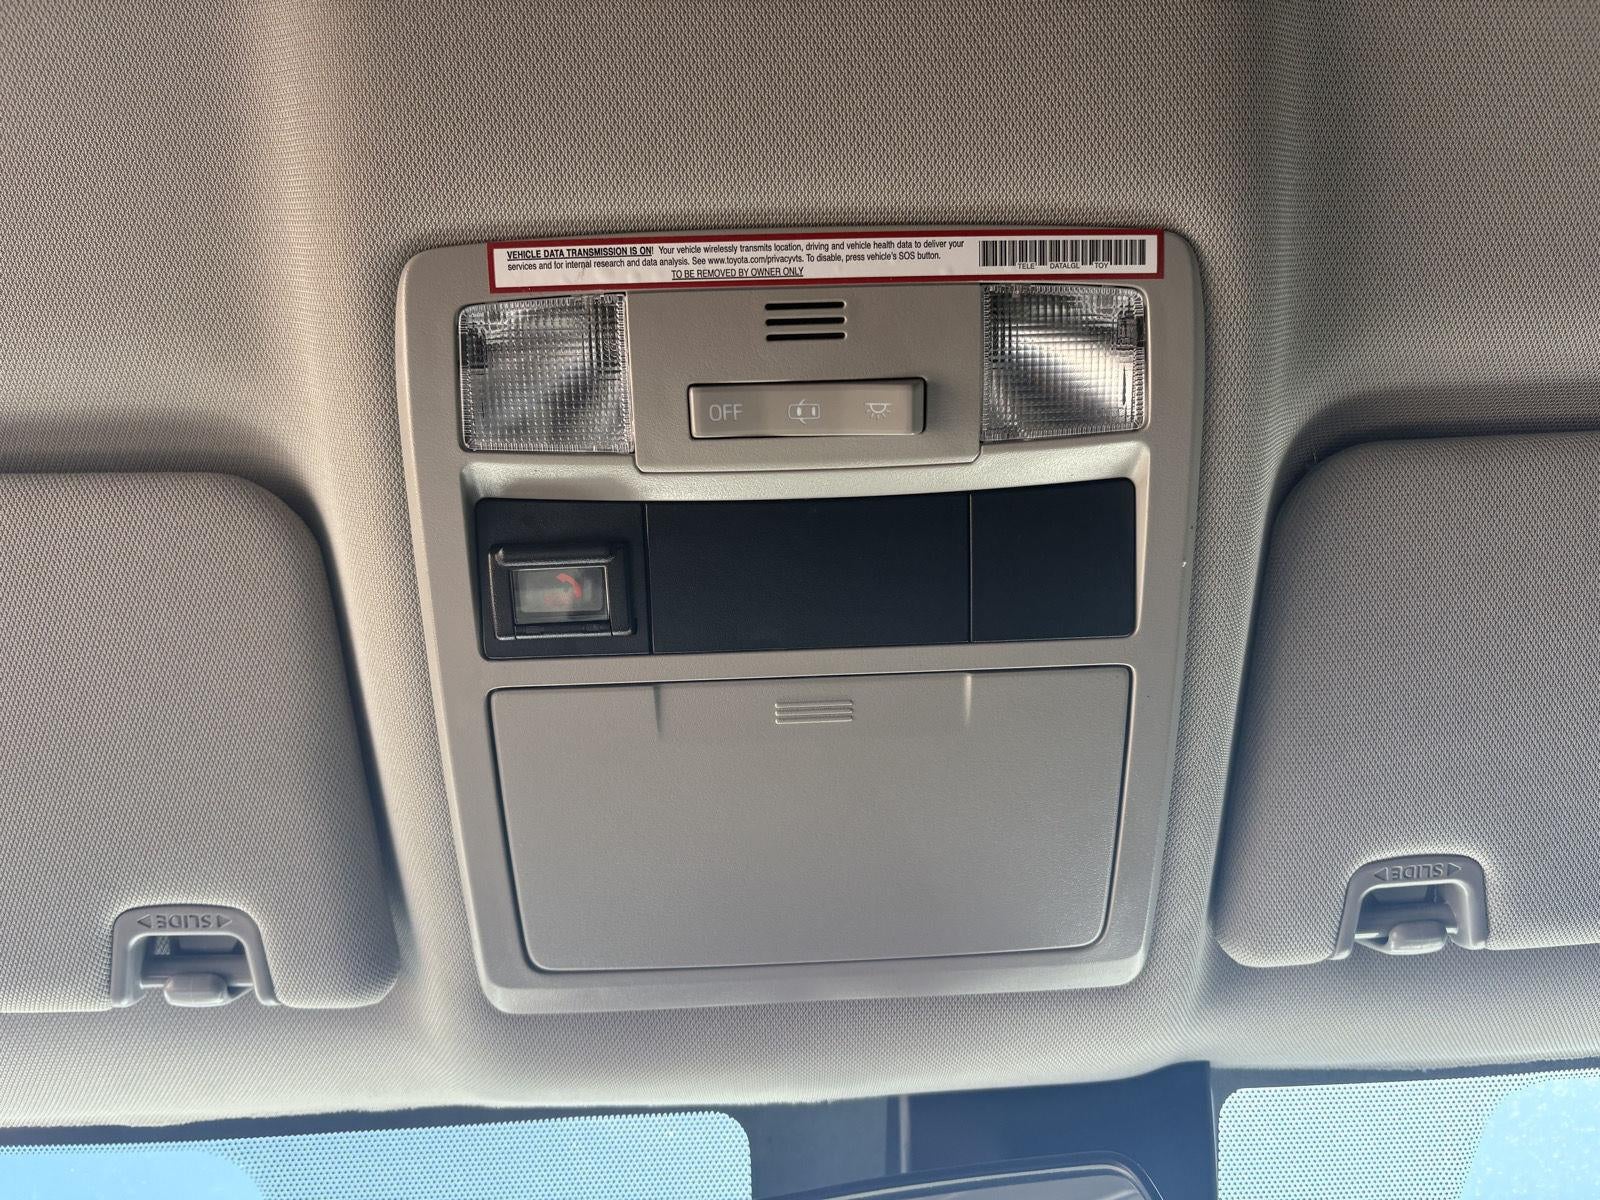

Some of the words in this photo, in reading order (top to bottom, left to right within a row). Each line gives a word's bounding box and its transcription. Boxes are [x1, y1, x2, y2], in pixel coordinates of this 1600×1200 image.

[507, 250, 541, 259] VEHICLE
[544, 249, 564, 258] DATA
[566, 247, 628, 257] TRANSMISSION
[630, 247, 637, 255] IS
[640, 247, 653, 255] ON!
[659, 246, 674, 254] Your
[676, 245, 701, 254] vehicle
[703, 244, 738, 254] wirelessly
[740, 243, 772, 252] transmits
[774, 242, 803, 252] location,
[806, 242, 829, 252] driving
[831, 242, 844, 250] and
[847, 241, 871, 249] vehicle
[873, 241, 894, 249] health
[897, 240, 912, 249] data
[923, 240, 945, 248] deliver
[948, 241, 964, 250] your
[508, 261, 537, 271] services
[538, 261, 552, 270] and
[554, 261, 564, 269] for
[566, 260, 592, 269] internal
[594, 259, 625, 268] research
[626, 258, 640, 266] and
[642, 258, 657, 266] data
[659, 257, 689, 266] analysis.
[708, 254, 804, 265] www.toyota.com/privacyvts.
[806, 254, 814, 262] To
[816, 253, 844, 262] disable,
[866, 252, 897, 260] vehicle's
[899, 252, 915, 260] SOS
[917, 251, 940, 260] button.
[672, 270, 682, 278] TO
[684, 270, 695, 278] BE
[697, 268, 736, 277] REMOVED
[738, 268, 749, 277] BY
[751, 268, 781, 276] OWNER
[783, 267, 803, 276] ONLY
[709, 404, 742, 421] OFF
[1392, 862, 1444, 880] SLIDE
[156, 914, 211, 928] SLIDE
